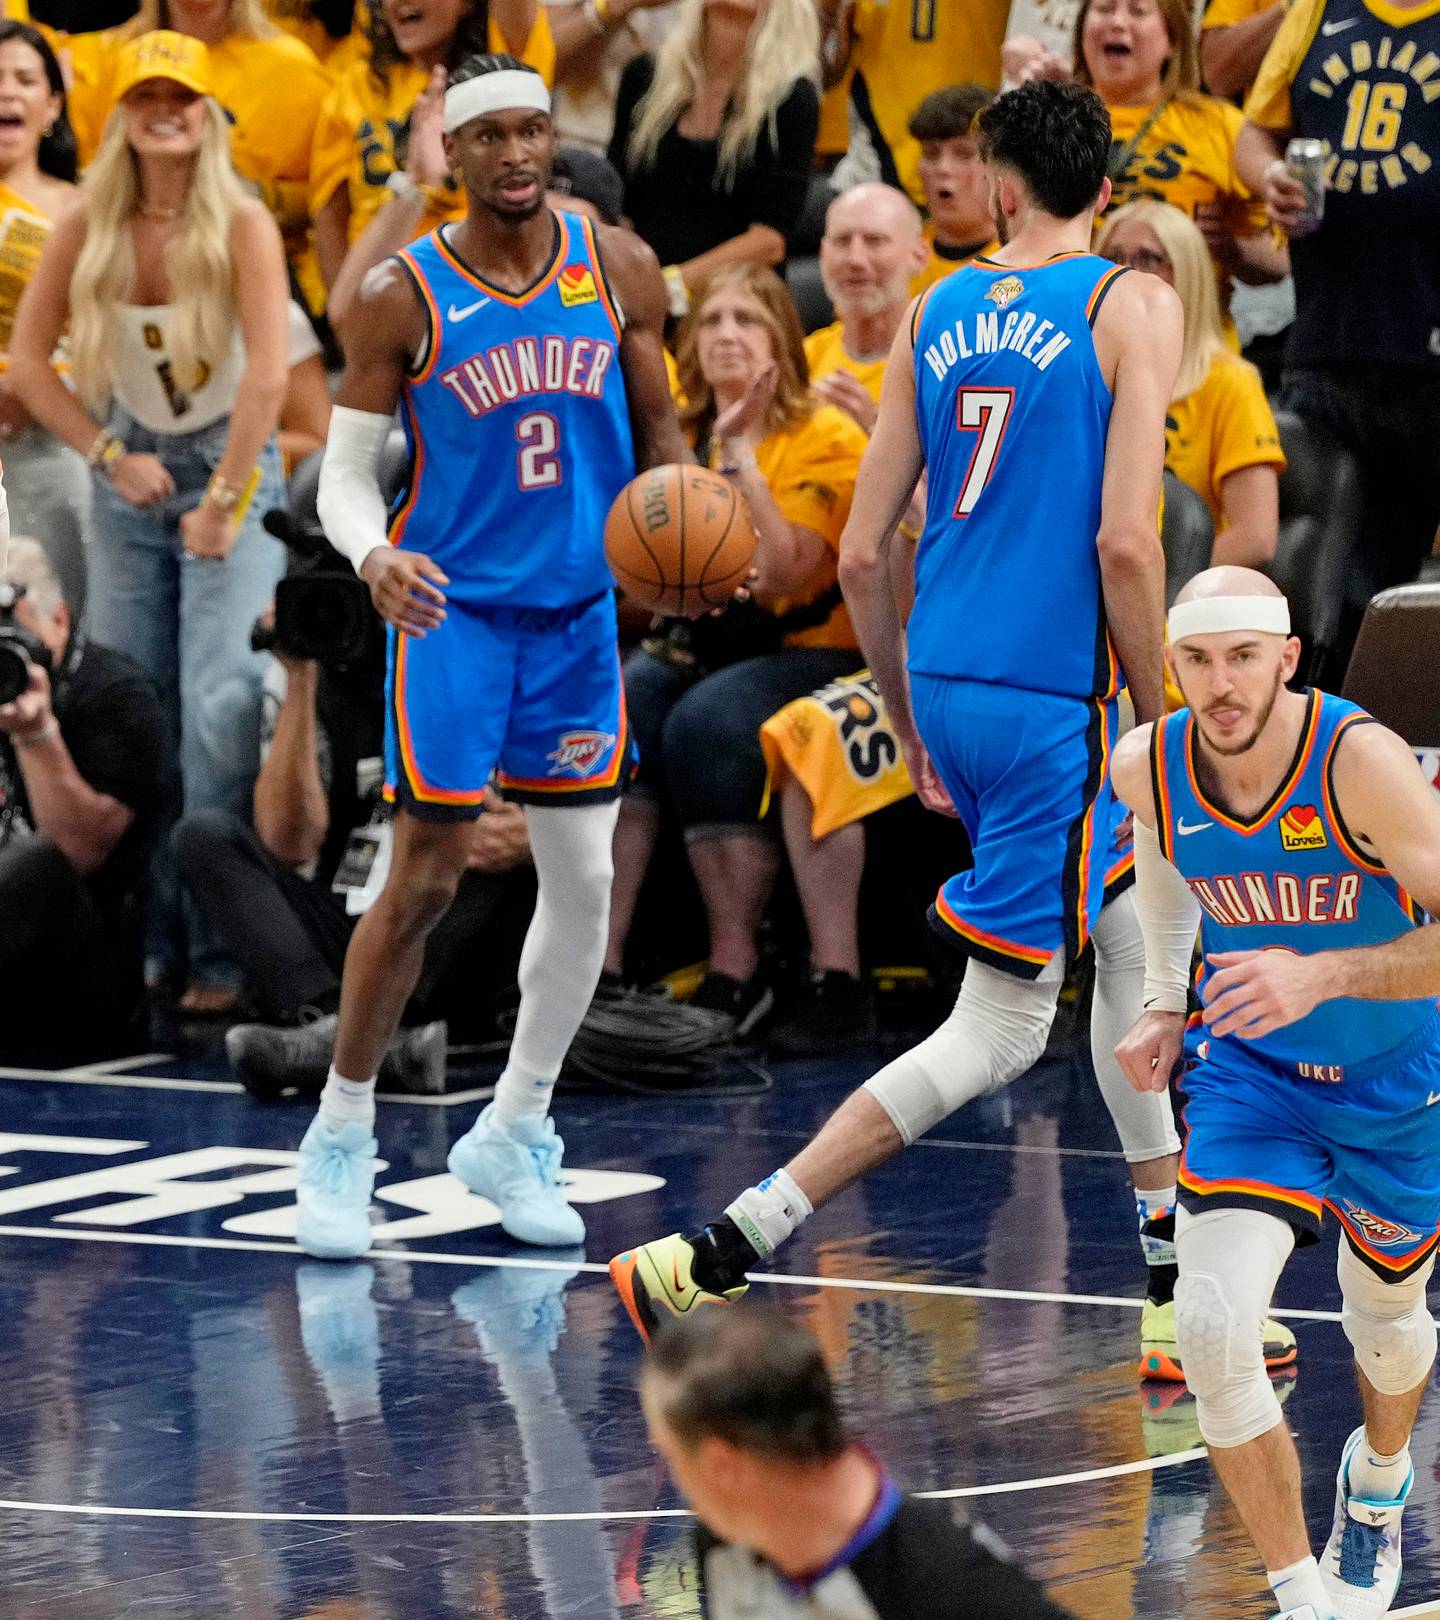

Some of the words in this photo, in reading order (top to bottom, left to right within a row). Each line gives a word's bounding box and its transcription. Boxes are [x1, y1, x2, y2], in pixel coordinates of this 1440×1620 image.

[1341, 80, 1408, 152] 16
[439, 335, 613, 418] THUNDER
[924, 311, 1072, 382] HOLMGREN
[516, 410, 562, 492] 2
[952, 386, 1015, 519] 7
